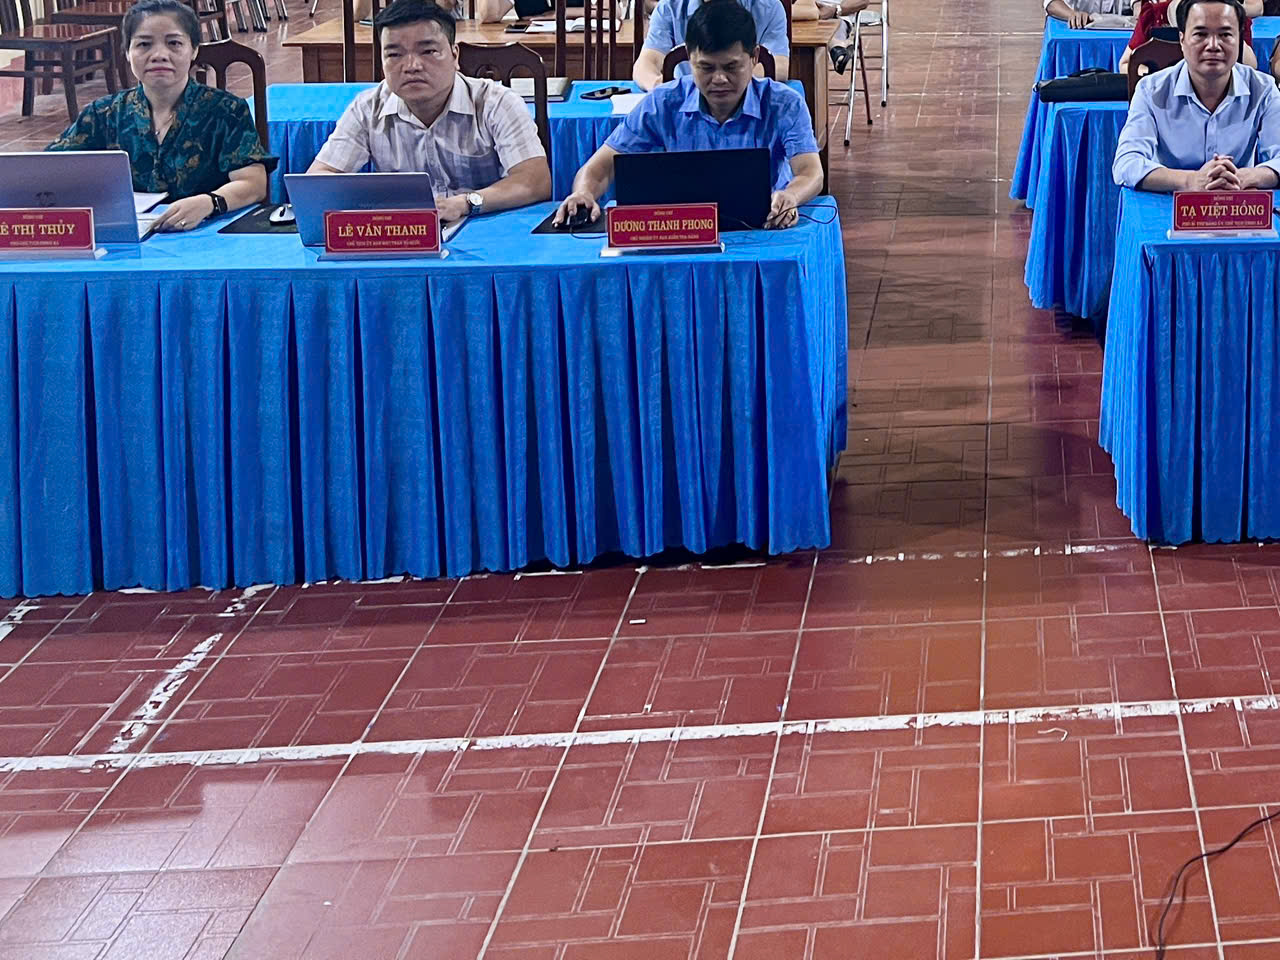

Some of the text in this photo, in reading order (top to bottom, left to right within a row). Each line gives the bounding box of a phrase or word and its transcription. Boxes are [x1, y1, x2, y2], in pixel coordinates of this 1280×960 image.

[1180, 205, 1197, 219] TẠ
[1199, 201, 1229, 219] VIỆT
[0, 221, 9, 235] Ê
[11, 224, 35, 238] THỊ
[338, 223, 427, 237] LÊ VĂN THANH
[613, 218, 714, 233] DƯƠNG THANH PHONG
